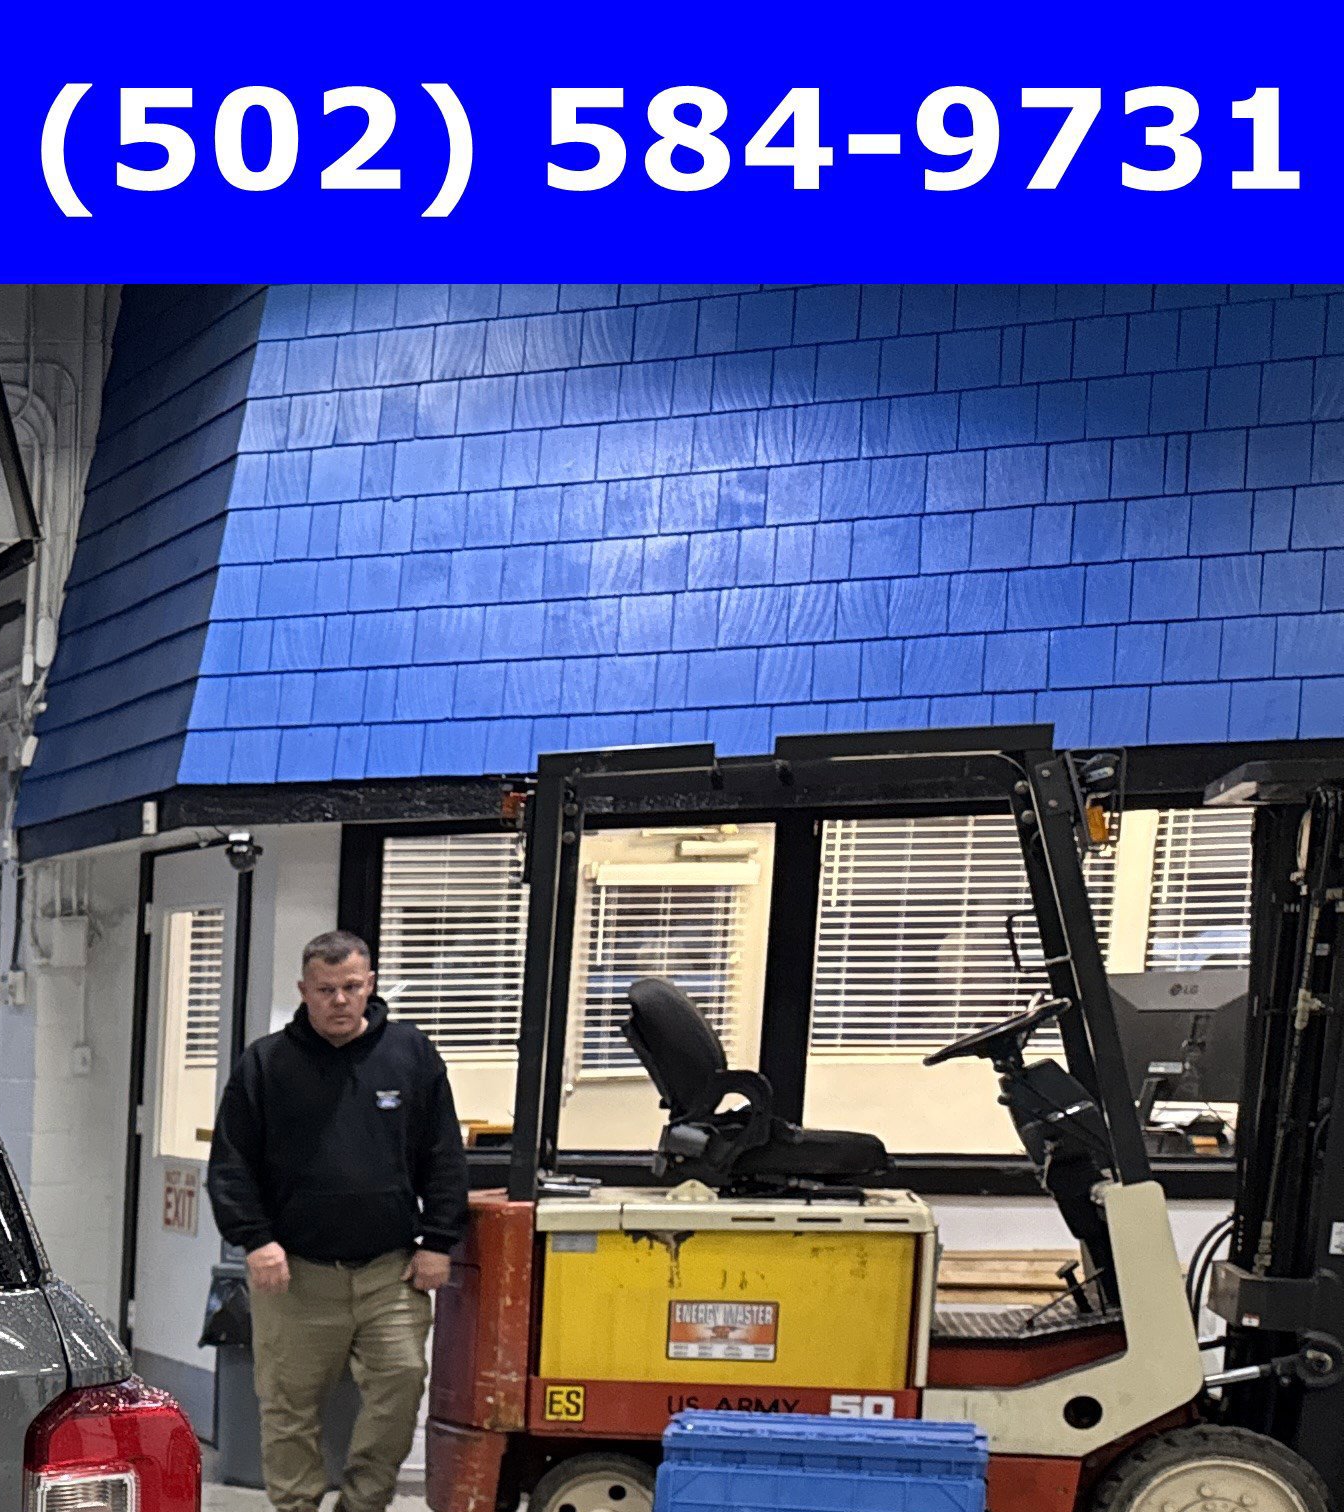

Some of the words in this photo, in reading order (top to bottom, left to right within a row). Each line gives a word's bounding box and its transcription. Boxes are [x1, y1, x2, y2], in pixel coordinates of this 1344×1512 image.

[163, 1186, 196, 1231] EXIT
[675, 1303, 723, 1325] ENERGY
[723, 1304, 773, 1325] MASTER
[548, 1389, 582, 1416] ES
[667, 1395, 700, 1414] US
[715, 1396, 800, 1413] ARMY
[830, 1394, 895, 1419] 50
